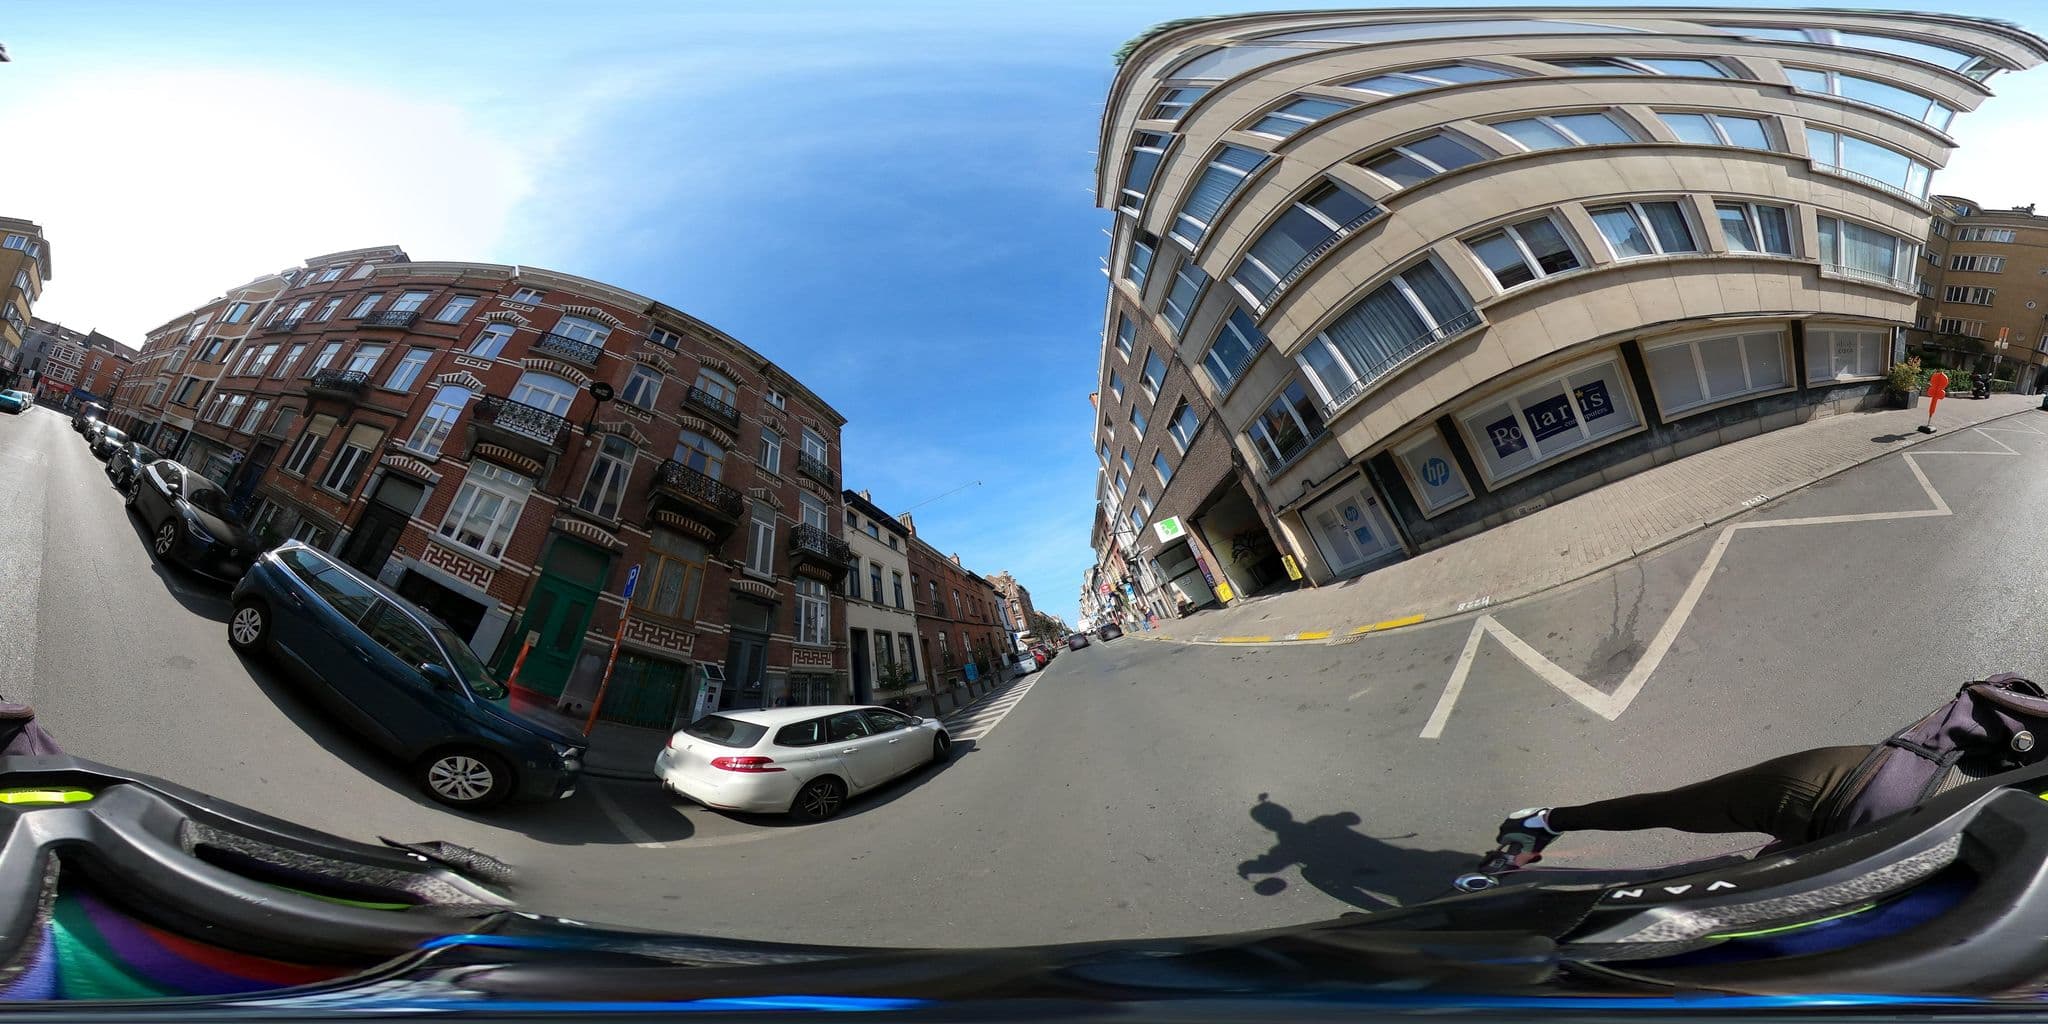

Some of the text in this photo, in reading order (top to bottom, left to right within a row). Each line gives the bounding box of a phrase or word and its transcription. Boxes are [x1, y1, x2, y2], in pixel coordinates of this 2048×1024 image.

[1493, 390, 1604, 447] Polaris
[1425, 458, 1447, 486] hp
[628, 567, 637, 585] P
[1612, 880, 1737, 899] VAN
